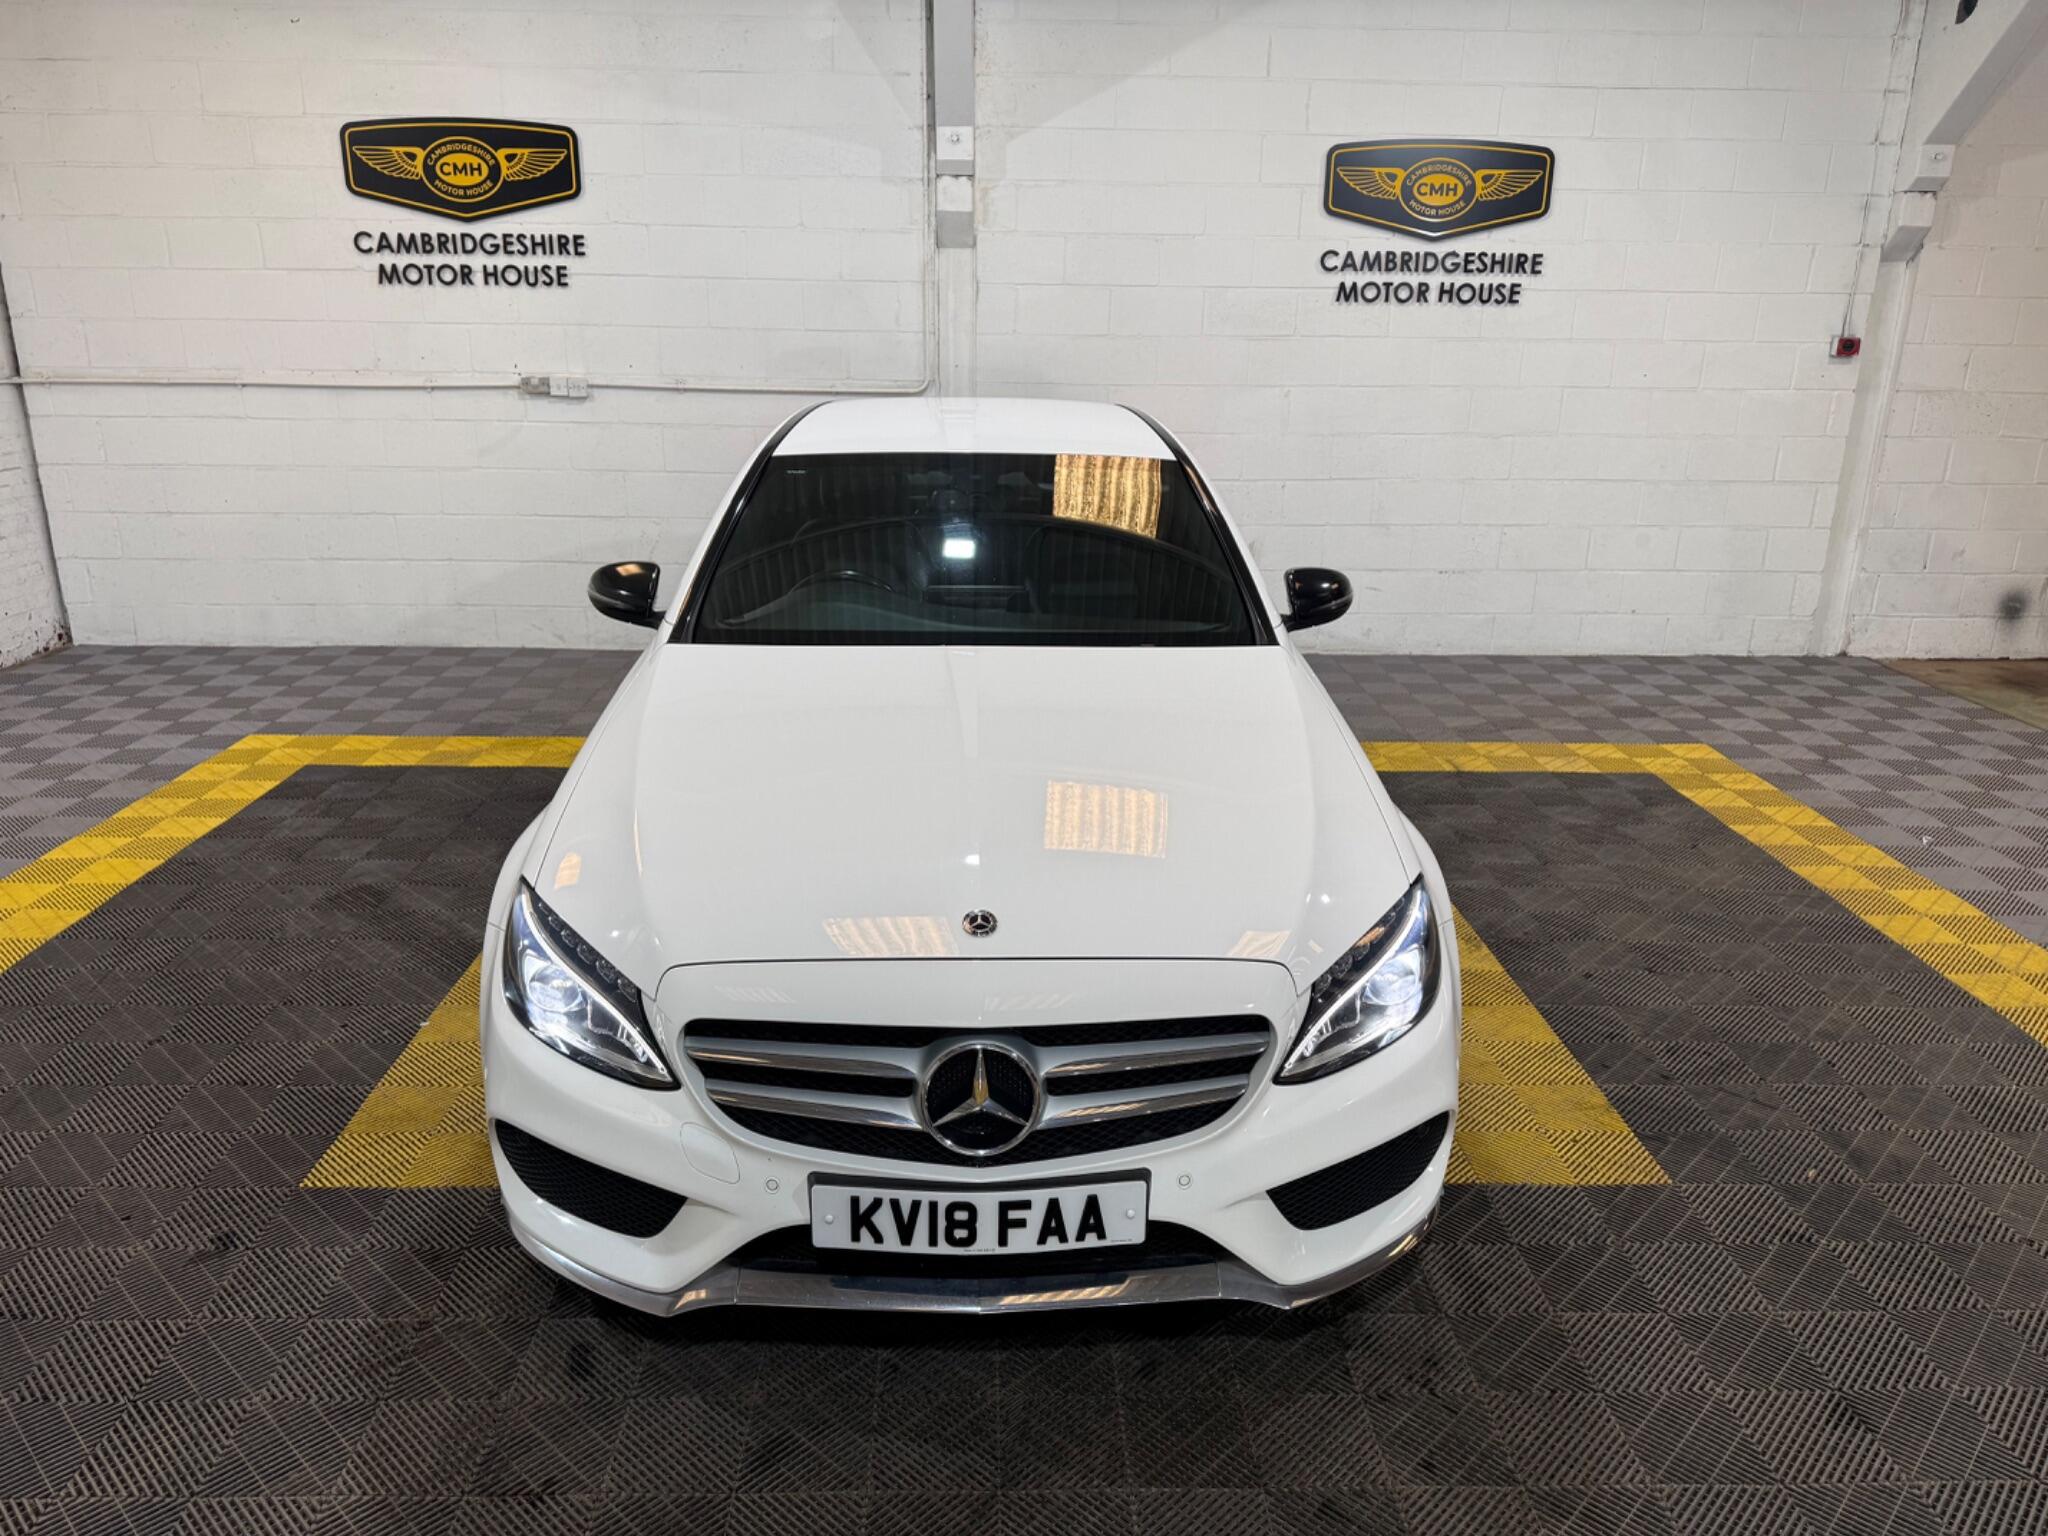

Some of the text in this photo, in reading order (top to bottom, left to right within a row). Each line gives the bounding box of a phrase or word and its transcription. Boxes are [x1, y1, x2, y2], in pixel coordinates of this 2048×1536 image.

[427, 143, 496, 166] CAMBRIDGESHIRE
[440, 162, 483, 177] CMH
[434, 180, 494, 196] MOTOR HOUSE
[1416, 182, 1458, 197] CMH
[1409, 200, 1437, 216] MOTOR
[354, 231, 586, 256] CAMBRIDGESHIRE
[1320, 249, 1544, 274] CAMBRIDGESHIRE
[378, 264, 569, 287] MOTOR HOUSE
[1336, 281, 1522, 304] MOTOR HOUSE
[850, 1194, 1107, 1248] KV18 FAA
